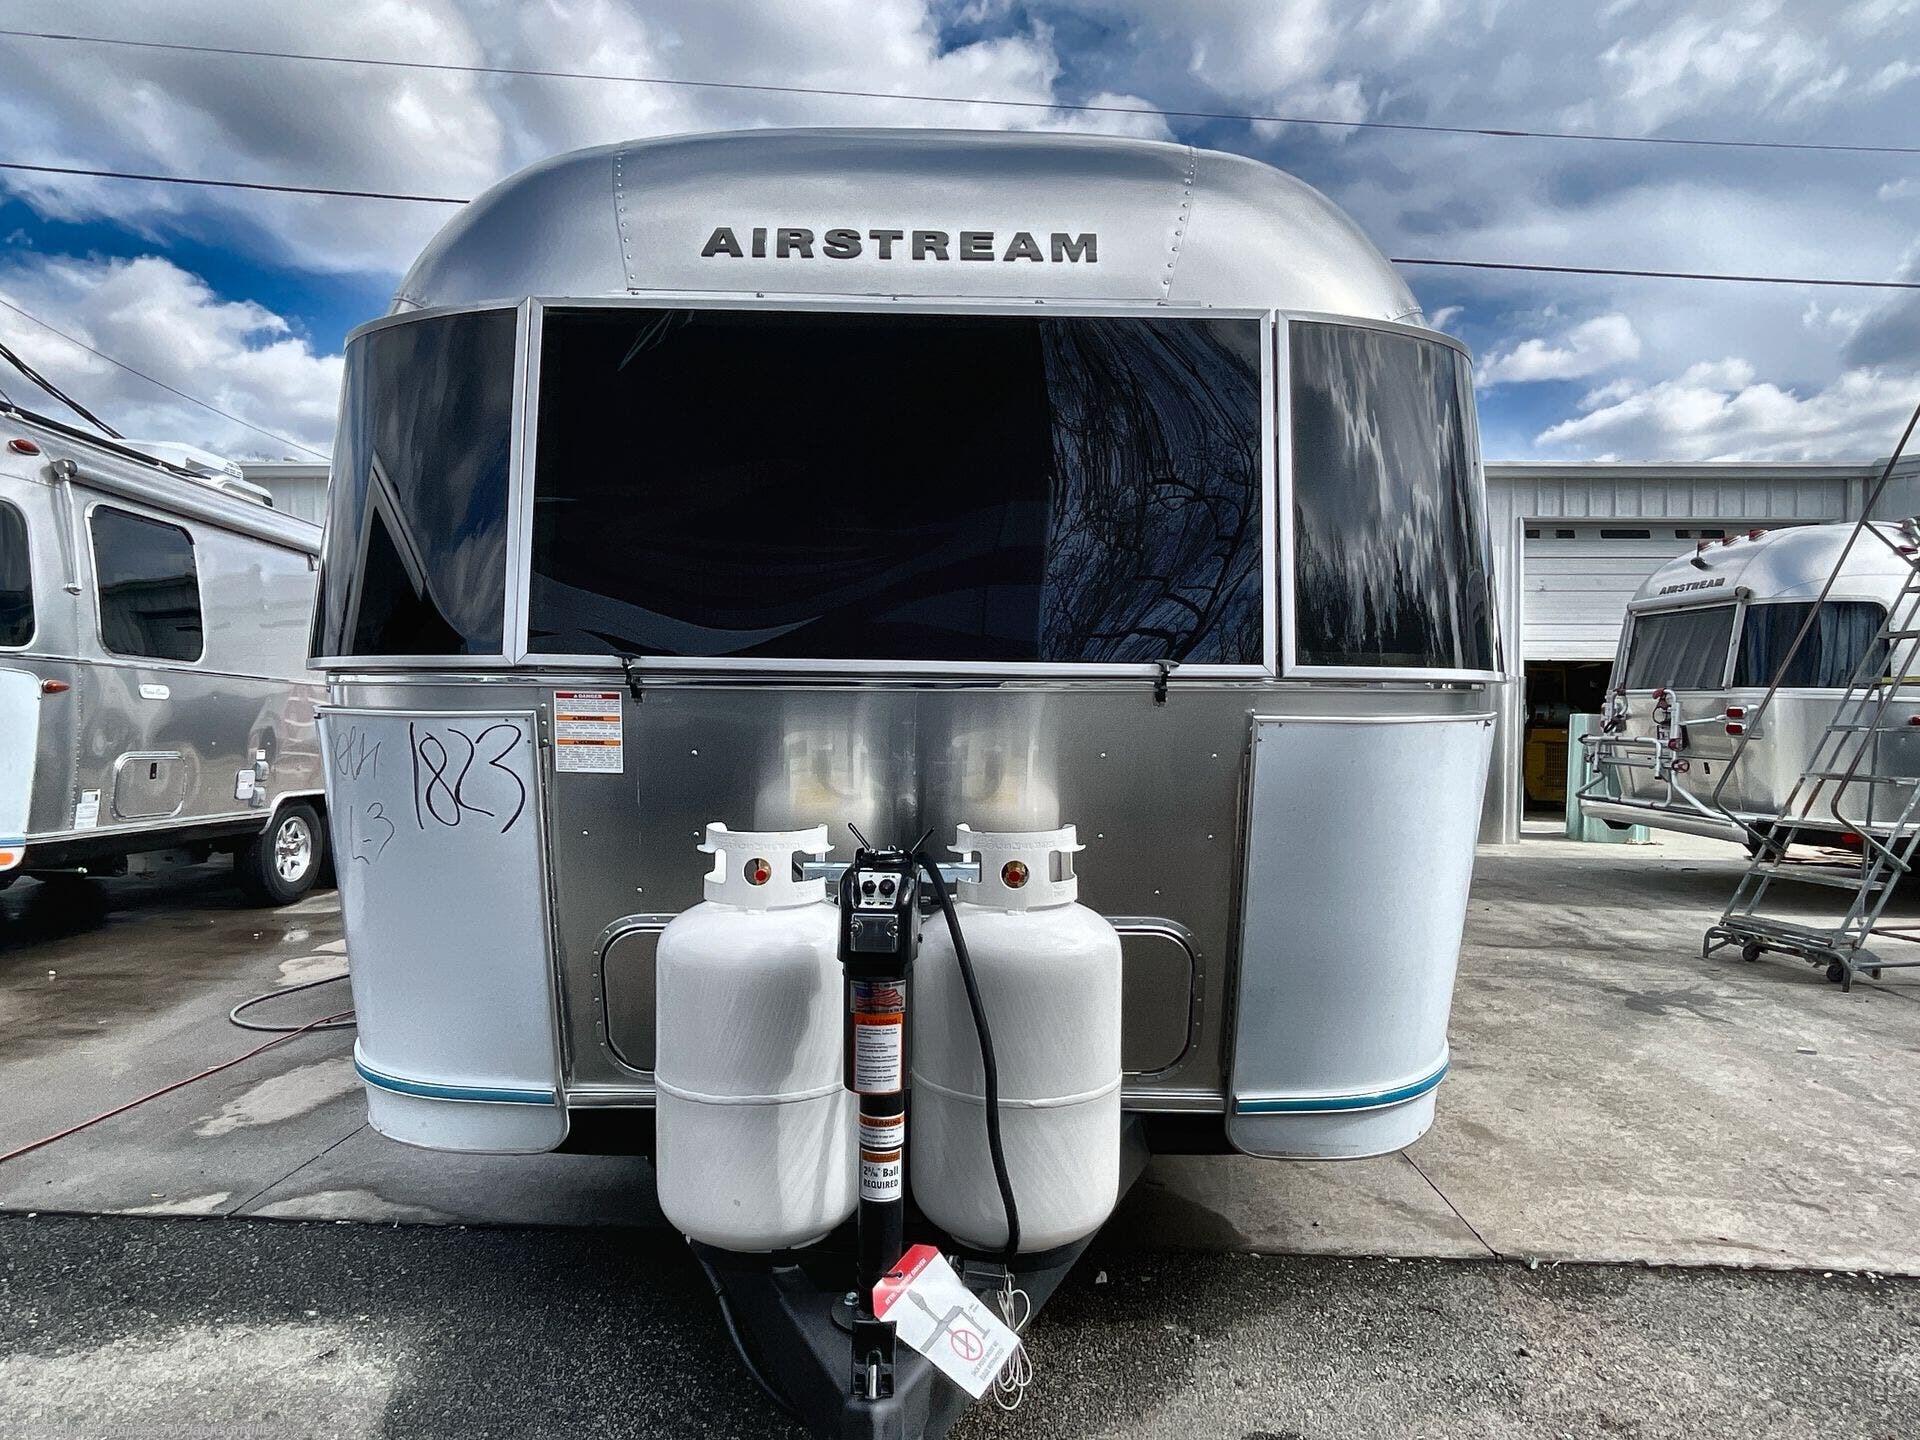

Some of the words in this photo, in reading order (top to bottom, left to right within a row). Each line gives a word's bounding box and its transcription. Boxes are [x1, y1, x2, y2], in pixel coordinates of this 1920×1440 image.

[701, 227, 1098, 263] AIRSTREAM
[1659, 577, 1725, 595] AIRSTREAM
[409, 720, 526, 834] 1823
[882, 1166, 899, 1178] Ball
[863, 1179, 899, 1190] REQUIRED
[910, 1257, 927, 1276] DRIVER
